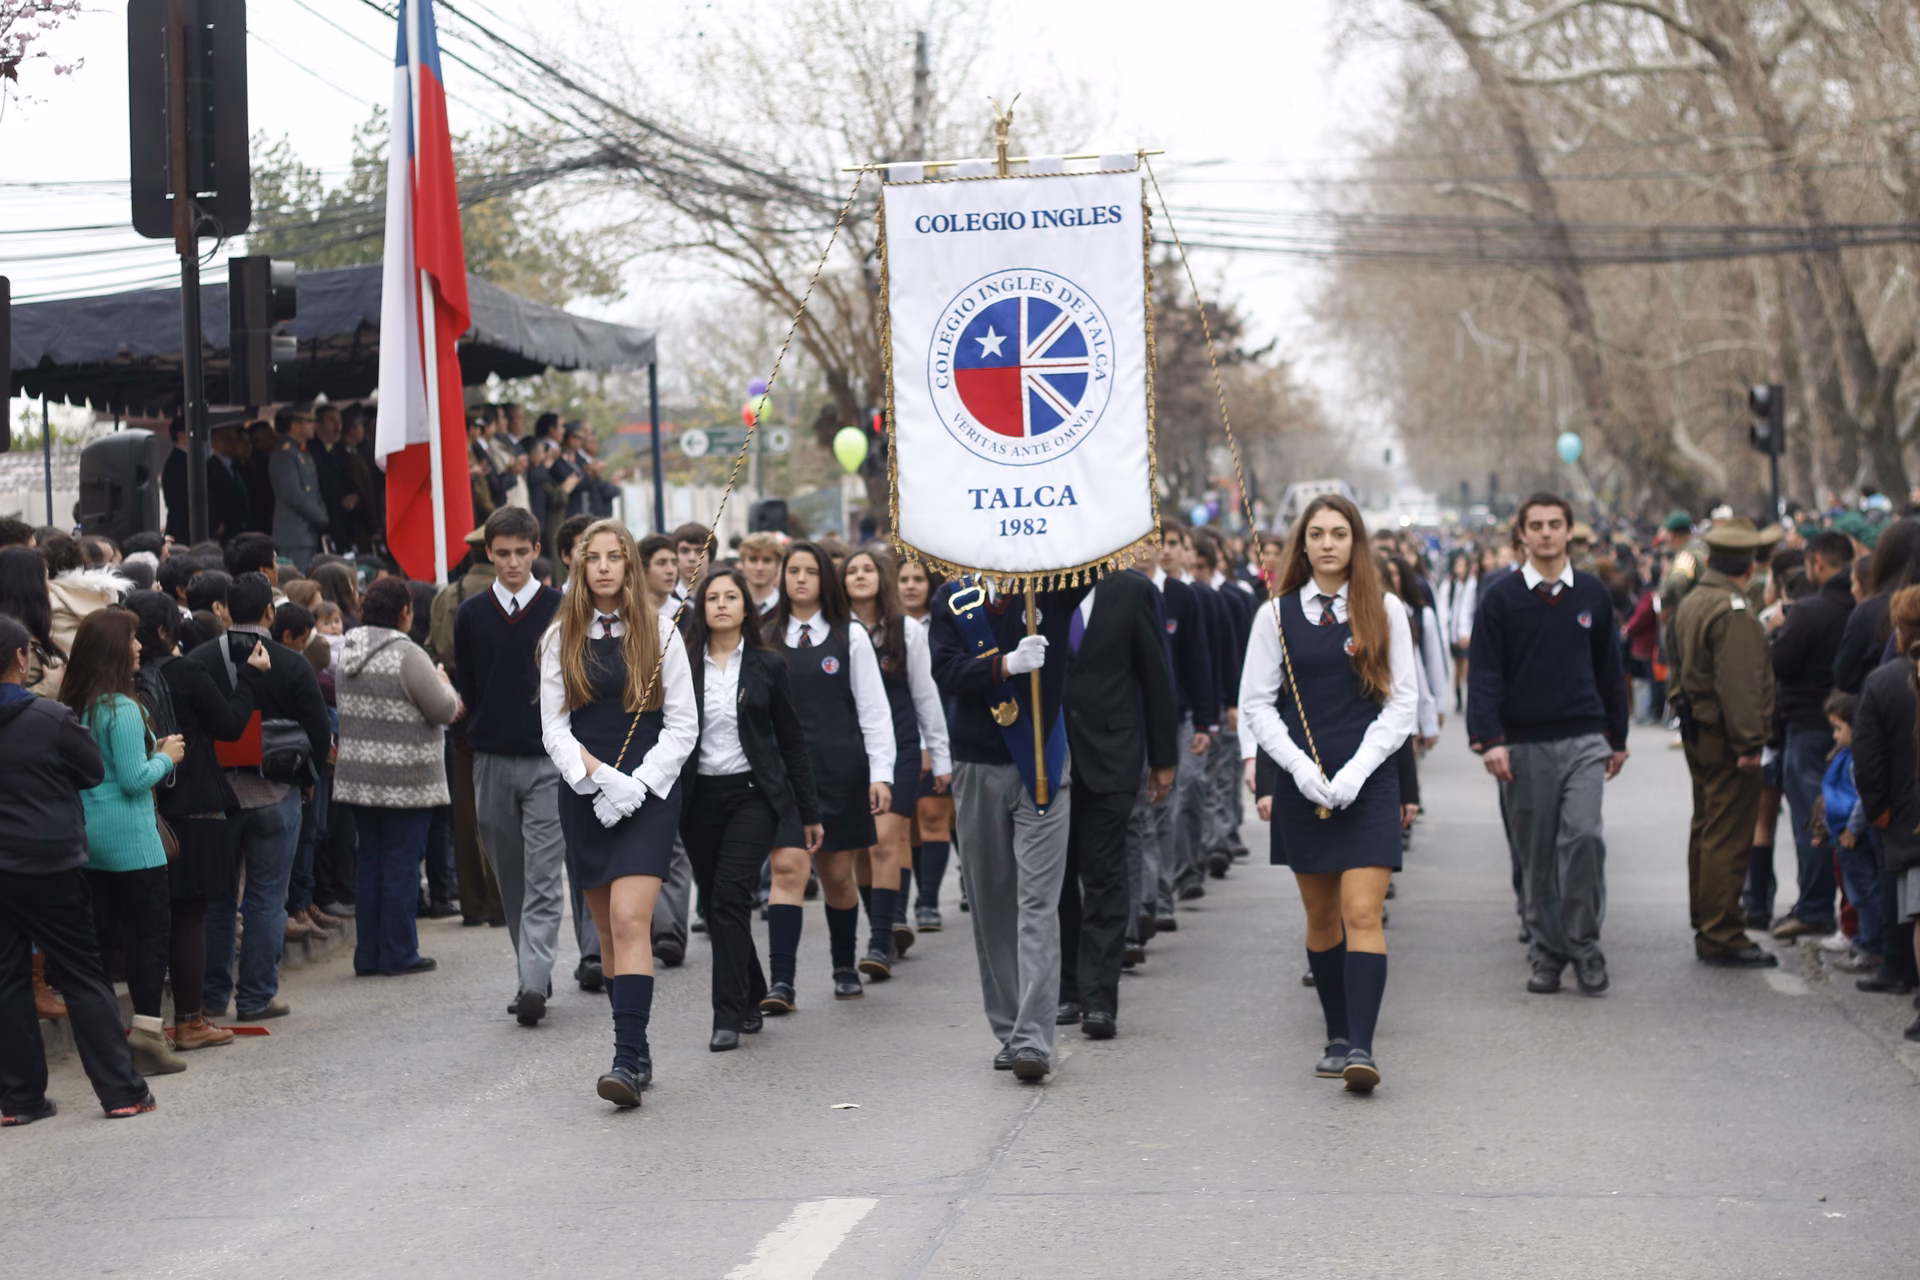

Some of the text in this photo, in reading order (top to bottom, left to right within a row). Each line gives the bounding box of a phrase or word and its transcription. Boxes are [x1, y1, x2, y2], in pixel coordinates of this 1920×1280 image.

[915, 205, 1122, 234] COLEGIO INGLES
[935, 276, 1107, 389] COLEGIO INGLES DE TALCA
[953, 408, 1095, 457] VERITAS ANTE OMNIA
[968, 485, 1078, 510] TALCA
[999, 517, 1048, 537] 1982
